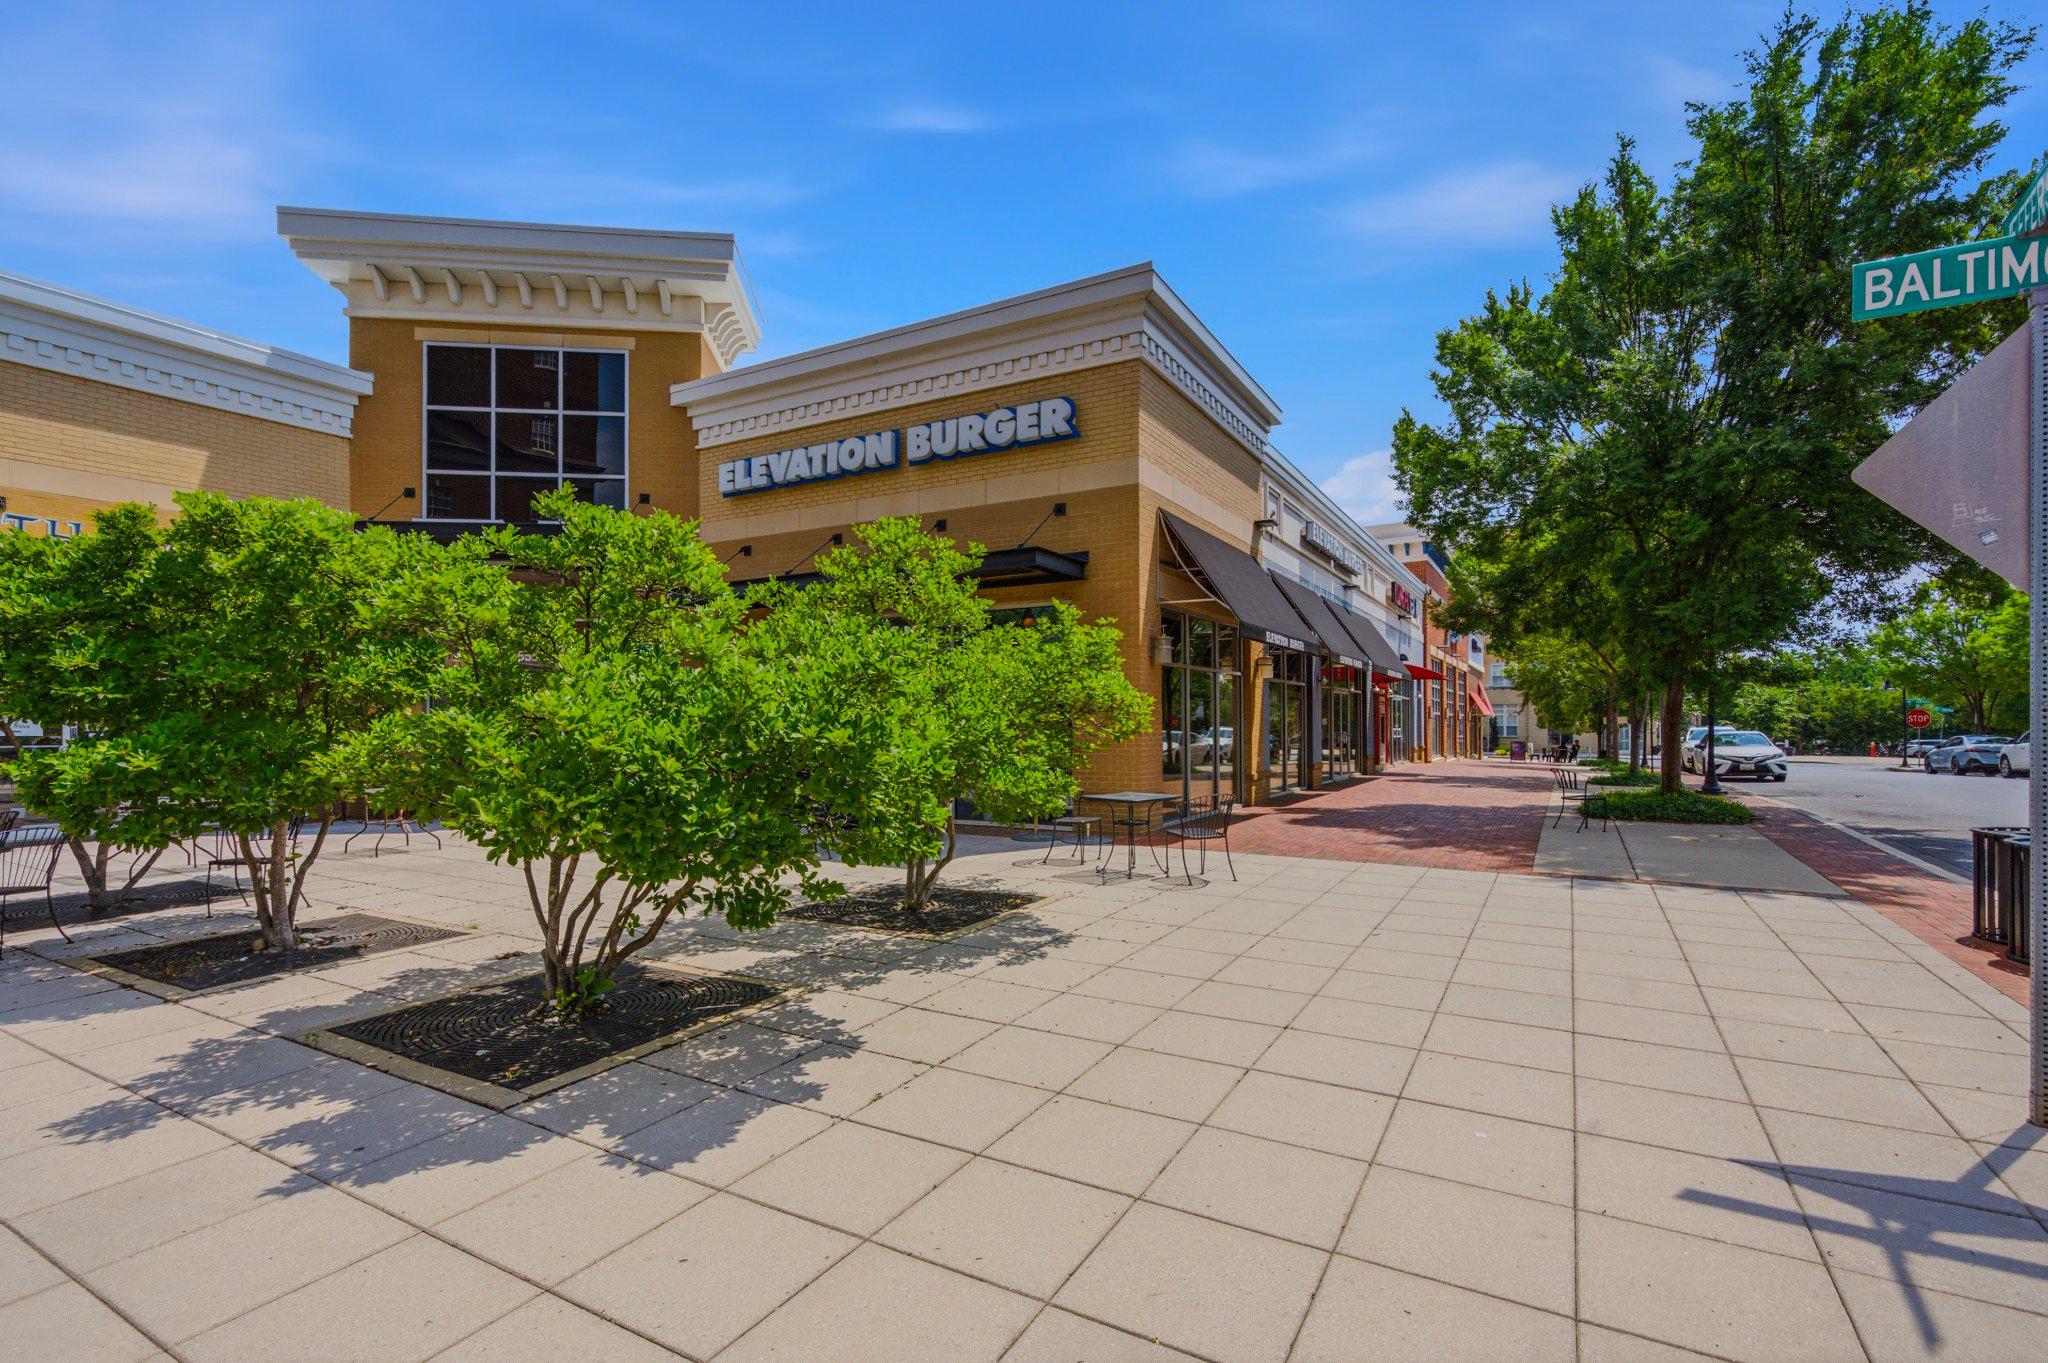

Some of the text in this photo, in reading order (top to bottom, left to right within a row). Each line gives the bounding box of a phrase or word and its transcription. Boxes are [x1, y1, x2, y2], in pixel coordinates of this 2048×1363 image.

[1865, 241, 2048, 311] BALTIM
[719, 397, 1078, 496] ELEVATION BURGER
[1908, 714, 1930, 722] STOP
